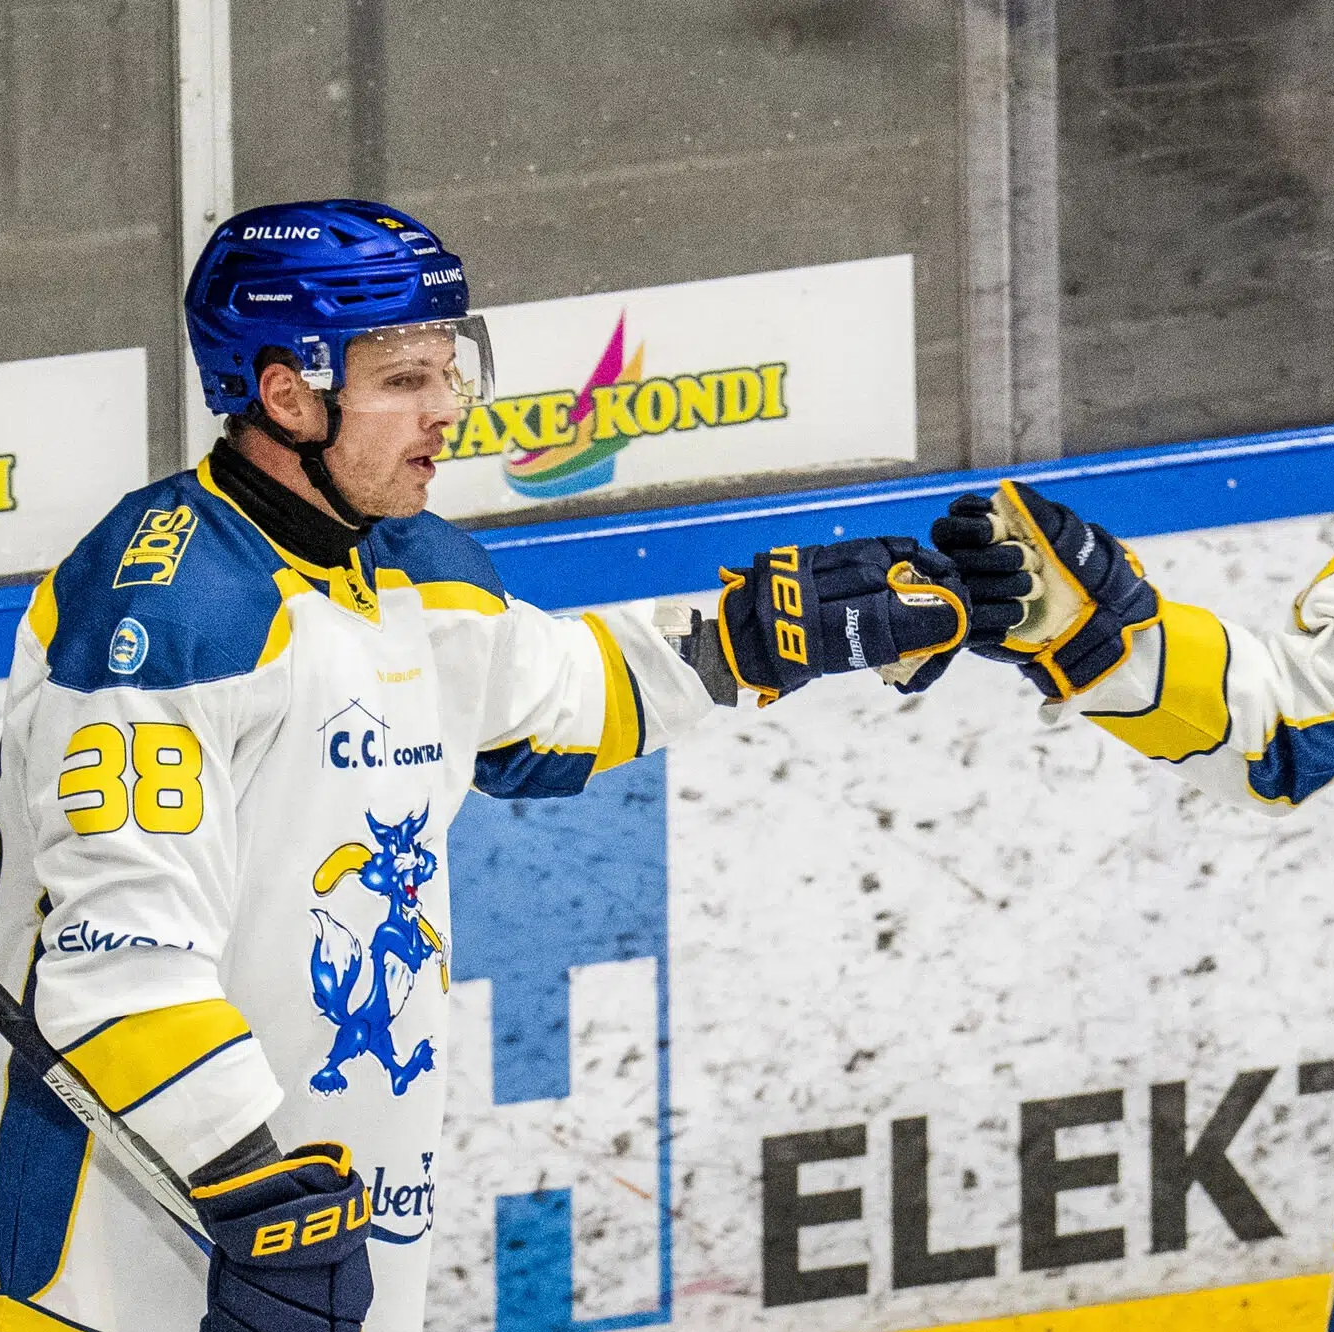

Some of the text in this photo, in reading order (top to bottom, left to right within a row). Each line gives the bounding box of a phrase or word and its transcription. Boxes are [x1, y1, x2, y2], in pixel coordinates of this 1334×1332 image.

[243, 226, 320, 240] DILLING
[422, 267, 463, 287] DILLING
[591, 362, 789, 438] KONDI
[123, 505, 193, 582] jbs
[58, 722, 204, 837] 38
